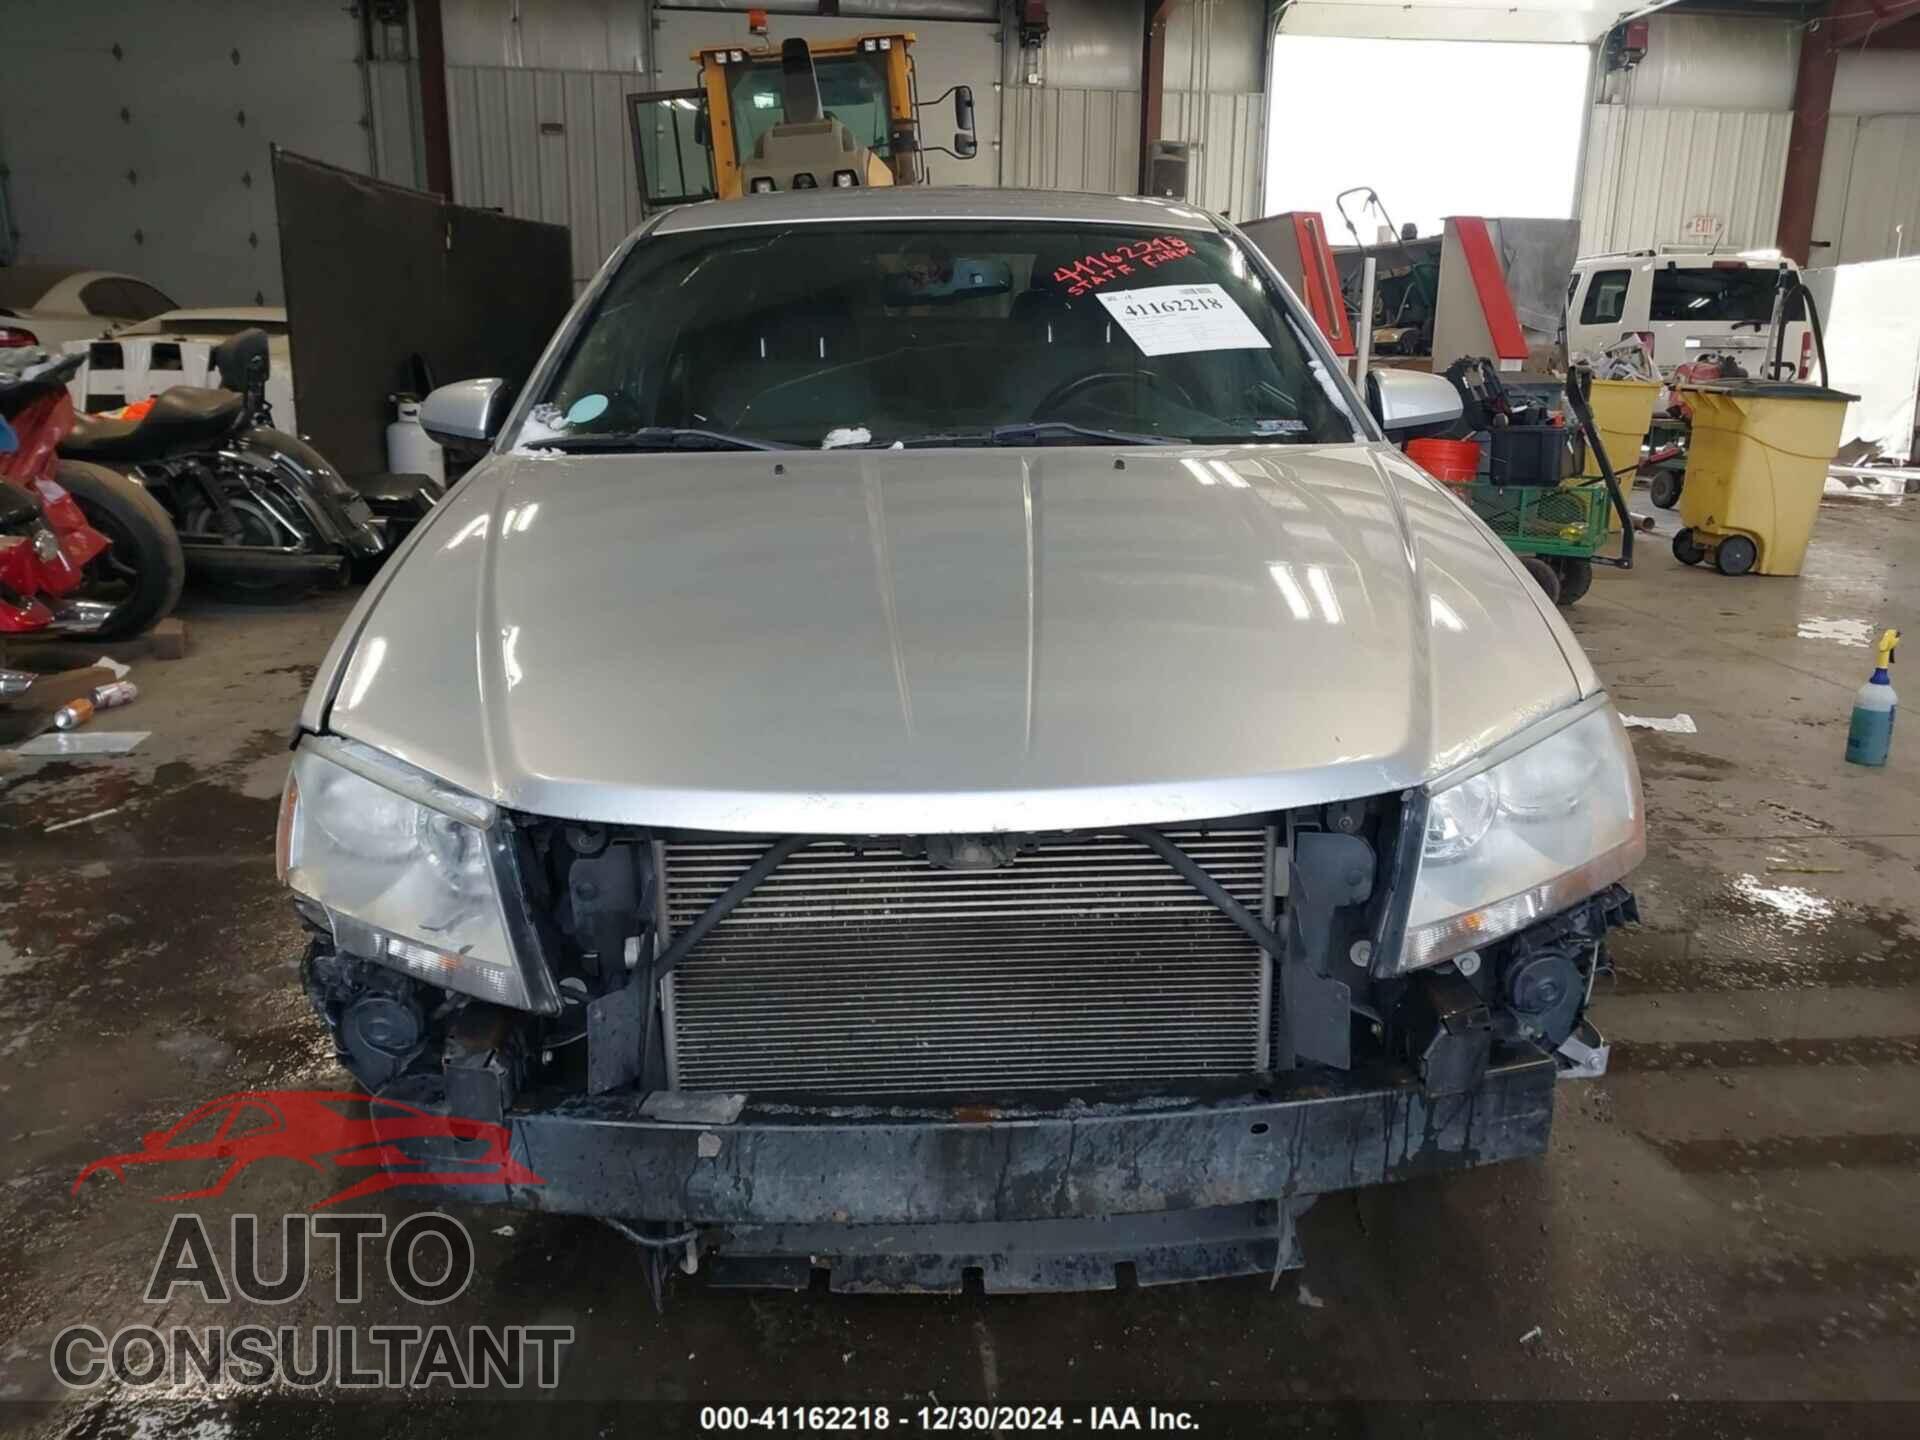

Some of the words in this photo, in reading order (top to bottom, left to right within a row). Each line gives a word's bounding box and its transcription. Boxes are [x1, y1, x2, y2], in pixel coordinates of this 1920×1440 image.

[1695, 216, 1712, 233] EXIT
[1054, 236, 1187, 282] 41162218
[1124, 296, 1223, 317] 41162218
